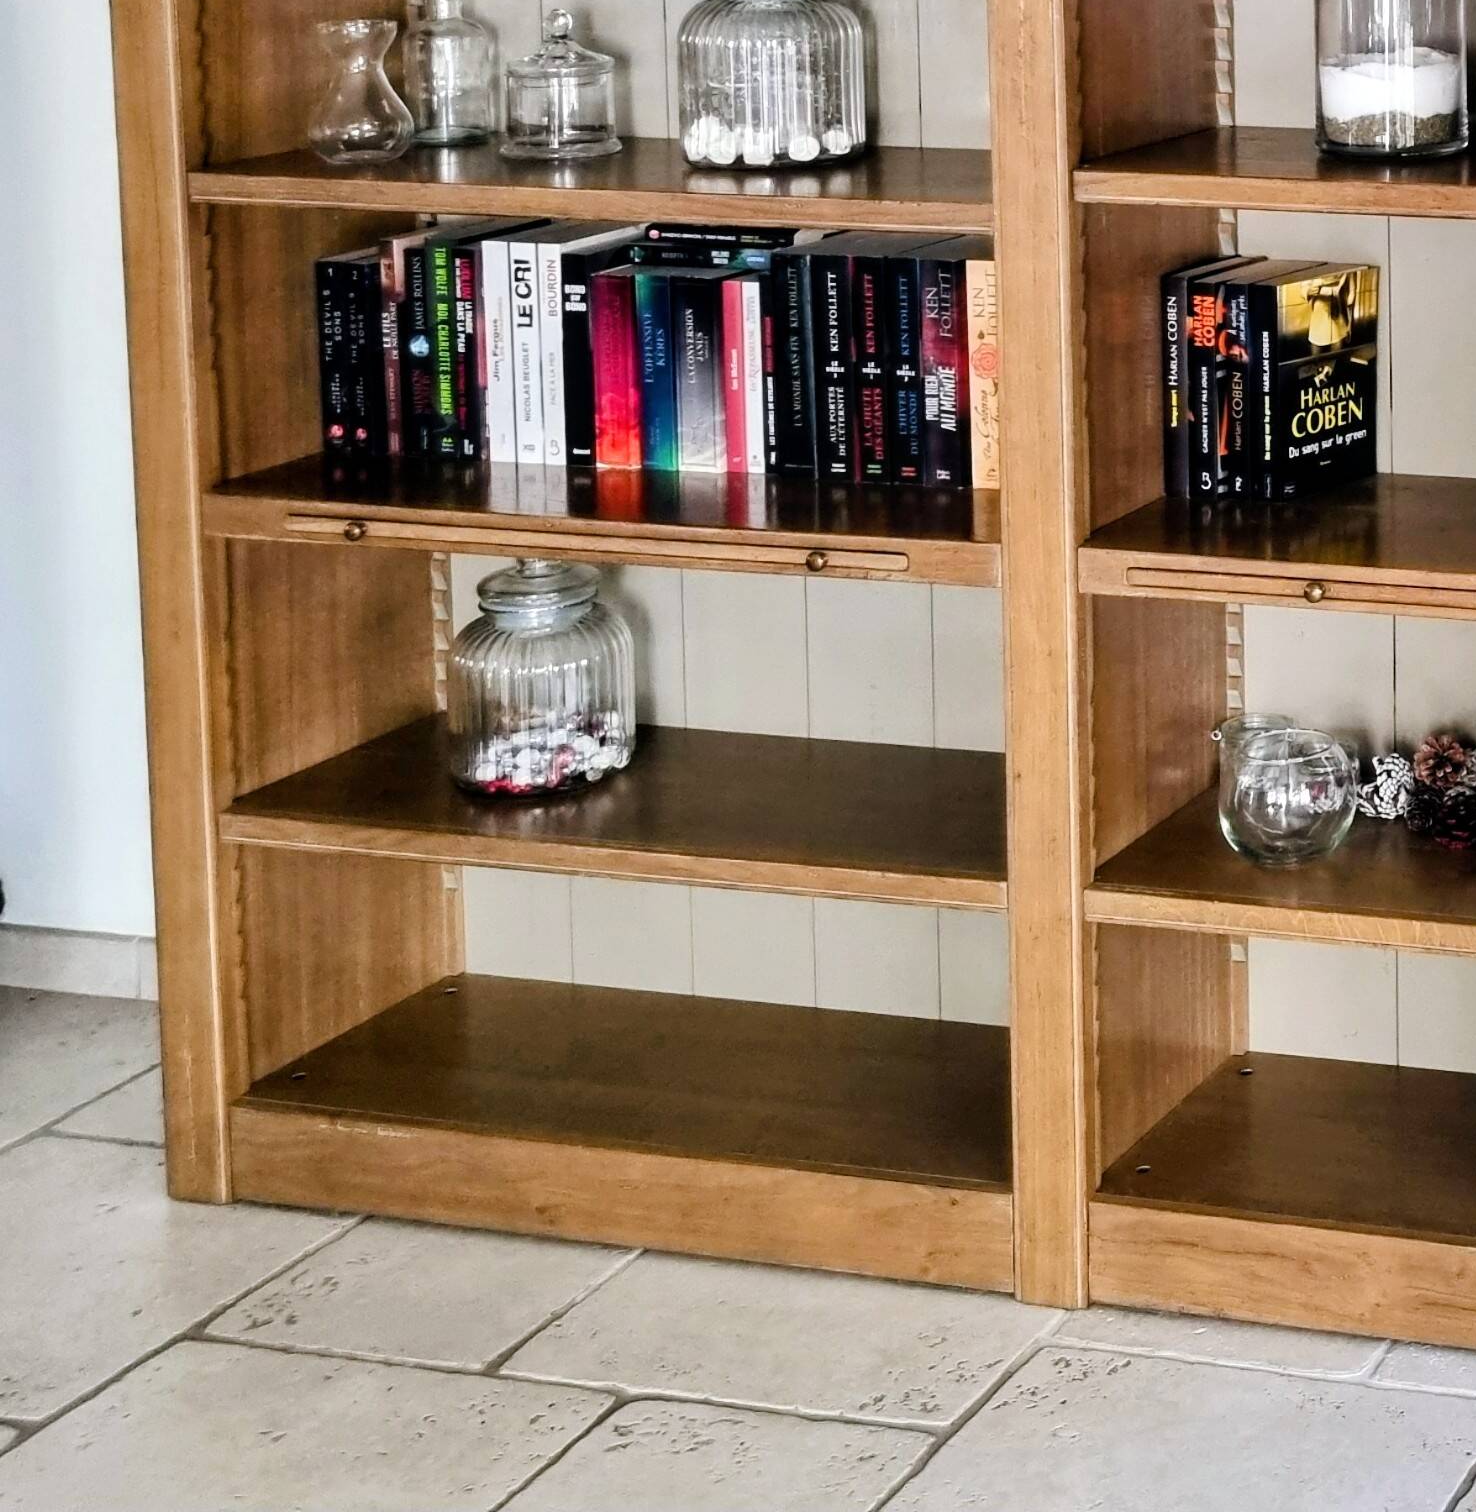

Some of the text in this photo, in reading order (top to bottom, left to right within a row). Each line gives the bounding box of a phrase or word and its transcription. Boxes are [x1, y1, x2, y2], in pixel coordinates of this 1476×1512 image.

[435, 247, 447, 266] TOM
[412, 256, 424, 330] JAMES ROLLINS
[435, 267, 448, 296] WOLFE
[545, 259, 558, 317] BOURDIN
[786, 265, 798, 307] FOLLETT
[925, 267, 953, 337] KEN FOLLETT
[971, 268, 998, 336] KEN FOLLETT
[381, 312, 391, 348] LE FILS
[456, 301, 465, 320] DANS
[456, 322, 465, 332] LA
[789, 308, 799, 329] KEN
[826, 271, 839, 352] KEN FOLLETT
[862, 273, 875, 354] KEN FOLLETT
[898, 276, 910, 356] KEN FOLLETT
[1167, 295, 1178, 342] COBEN
[1193, 295, 1203, 347] HARLAN
[1203, 296, 1215, 347] COBEN
[324, 340, 333, 361] THE
[438, 324, 451, 372] CHARLOTTE
[457, 332, 466, 353] PEAU
[491, 318, 500, 382] Jim Fergus
[513, 258, 533, 422] NICOLAS BEUGLET LE CRI
[684, 308, 695, 370] CONVERSION
[696, 331, 704, 362] JANUS
[789, 335, 799, 351] FIN
[1261, 331, 1269, 359] COBEN
[790, 353, 800, 377] SANS
[1168, 344, 1178, 386] HARLAN
[1262, 359, 1270, 393] HARLAN
[439, 373, 453, 415] SIMMONS
[791, 378, 802, 412] MONDE
[828, 386, 838, 443] AUX PORTES
[897, 389, 907, 435] L'HIVER
[924, 374, 939, 421] POUR RIEN
[937, 366, 957, 431] AU MONDE
[1231, 371, 1243, 419] COBEN
[1300, 381, 1356, 410] HARLAN
[862, 387, 873, 447] LA CHUTE
[872, 387, 884, 460] DES GÉANTS
[908, 390, 918, 455] DU MONDE
[1201, 424, 1209, 453] GAGNER
[1291, 397, 1363, 439] COBEN
[838, 442, 846, 456] DE
[1288, 429, 1367, 459] Du sang sur le green
